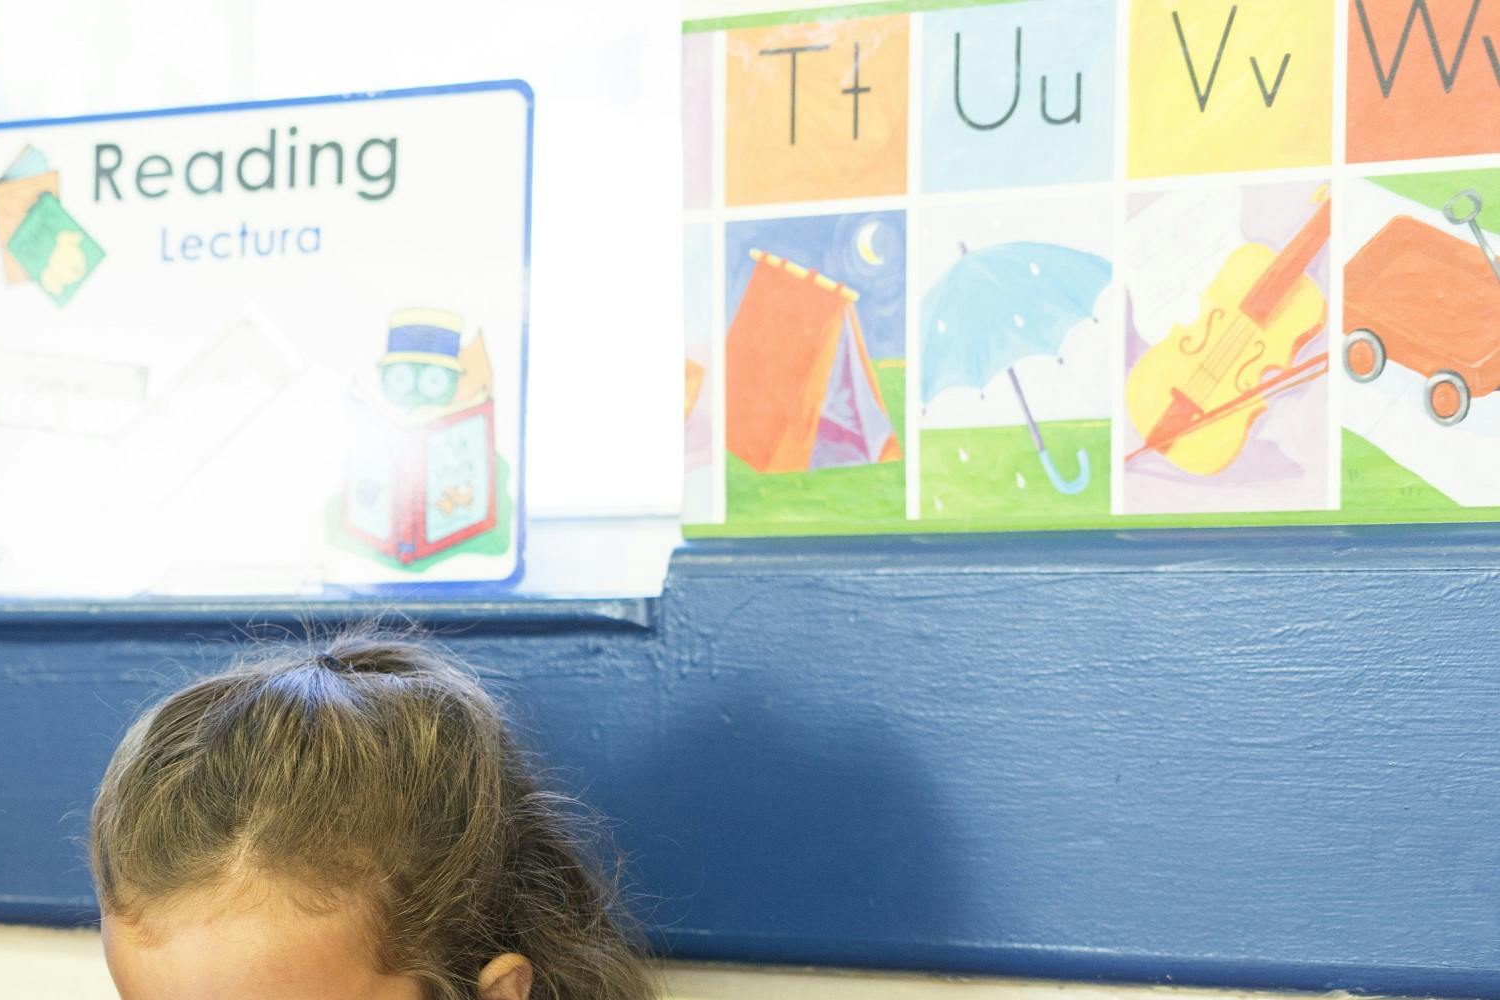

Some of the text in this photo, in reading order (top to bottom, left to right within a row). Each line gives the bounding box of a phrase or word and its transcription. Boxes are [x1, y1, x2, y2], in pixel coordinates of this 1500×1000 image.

[1353, 0, 1500, 98] W
[94, 126, 398, 202] Reading
[159, 222, 322, 262] Lectura
